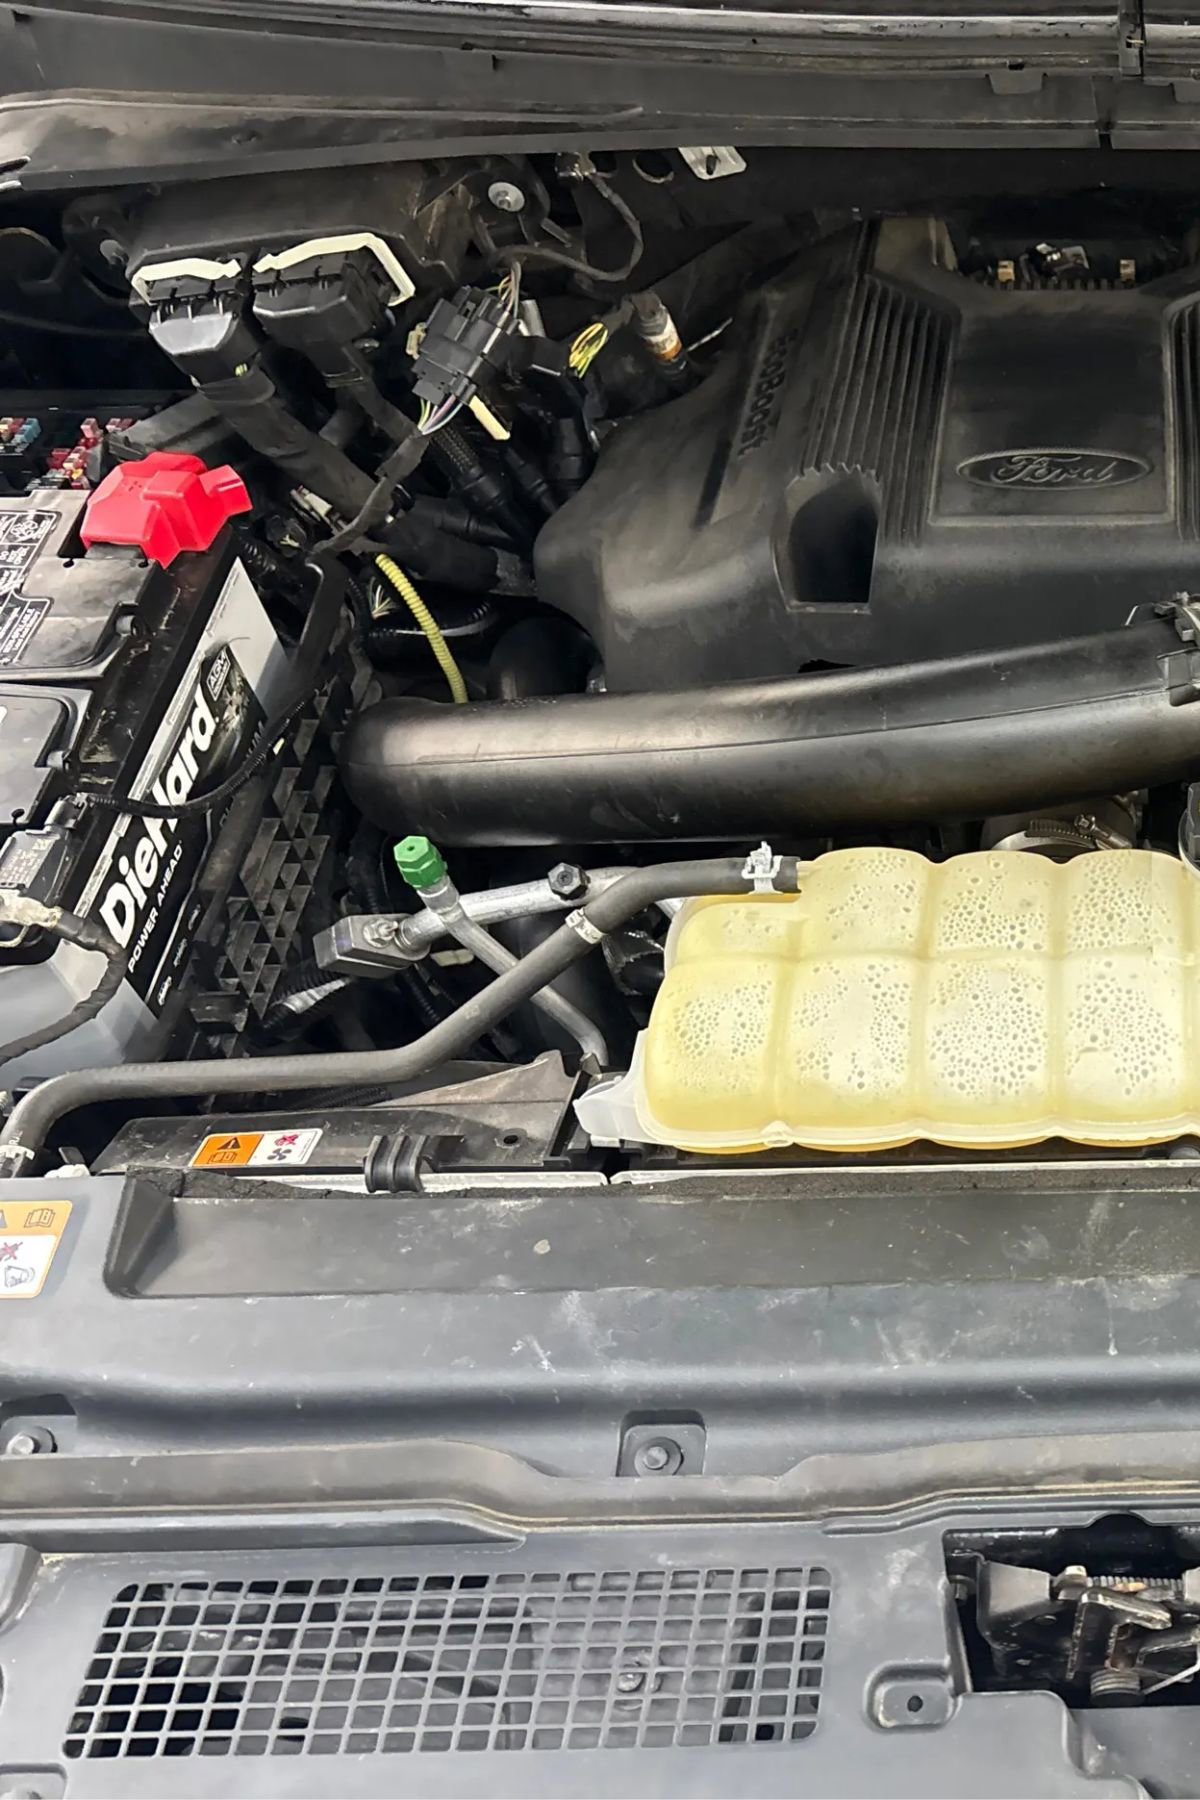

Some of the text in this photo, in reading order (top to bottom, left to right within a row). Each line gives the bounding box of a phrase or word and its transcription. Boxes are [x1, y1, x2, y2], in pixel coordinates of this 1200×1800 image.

[738, 326, 798, 457] EcoBoost
[990, 455, 1118, 484] Ford
[210, 649, 226, 690] AGM
[128, 844, 183, 974] POWER AHEAD
